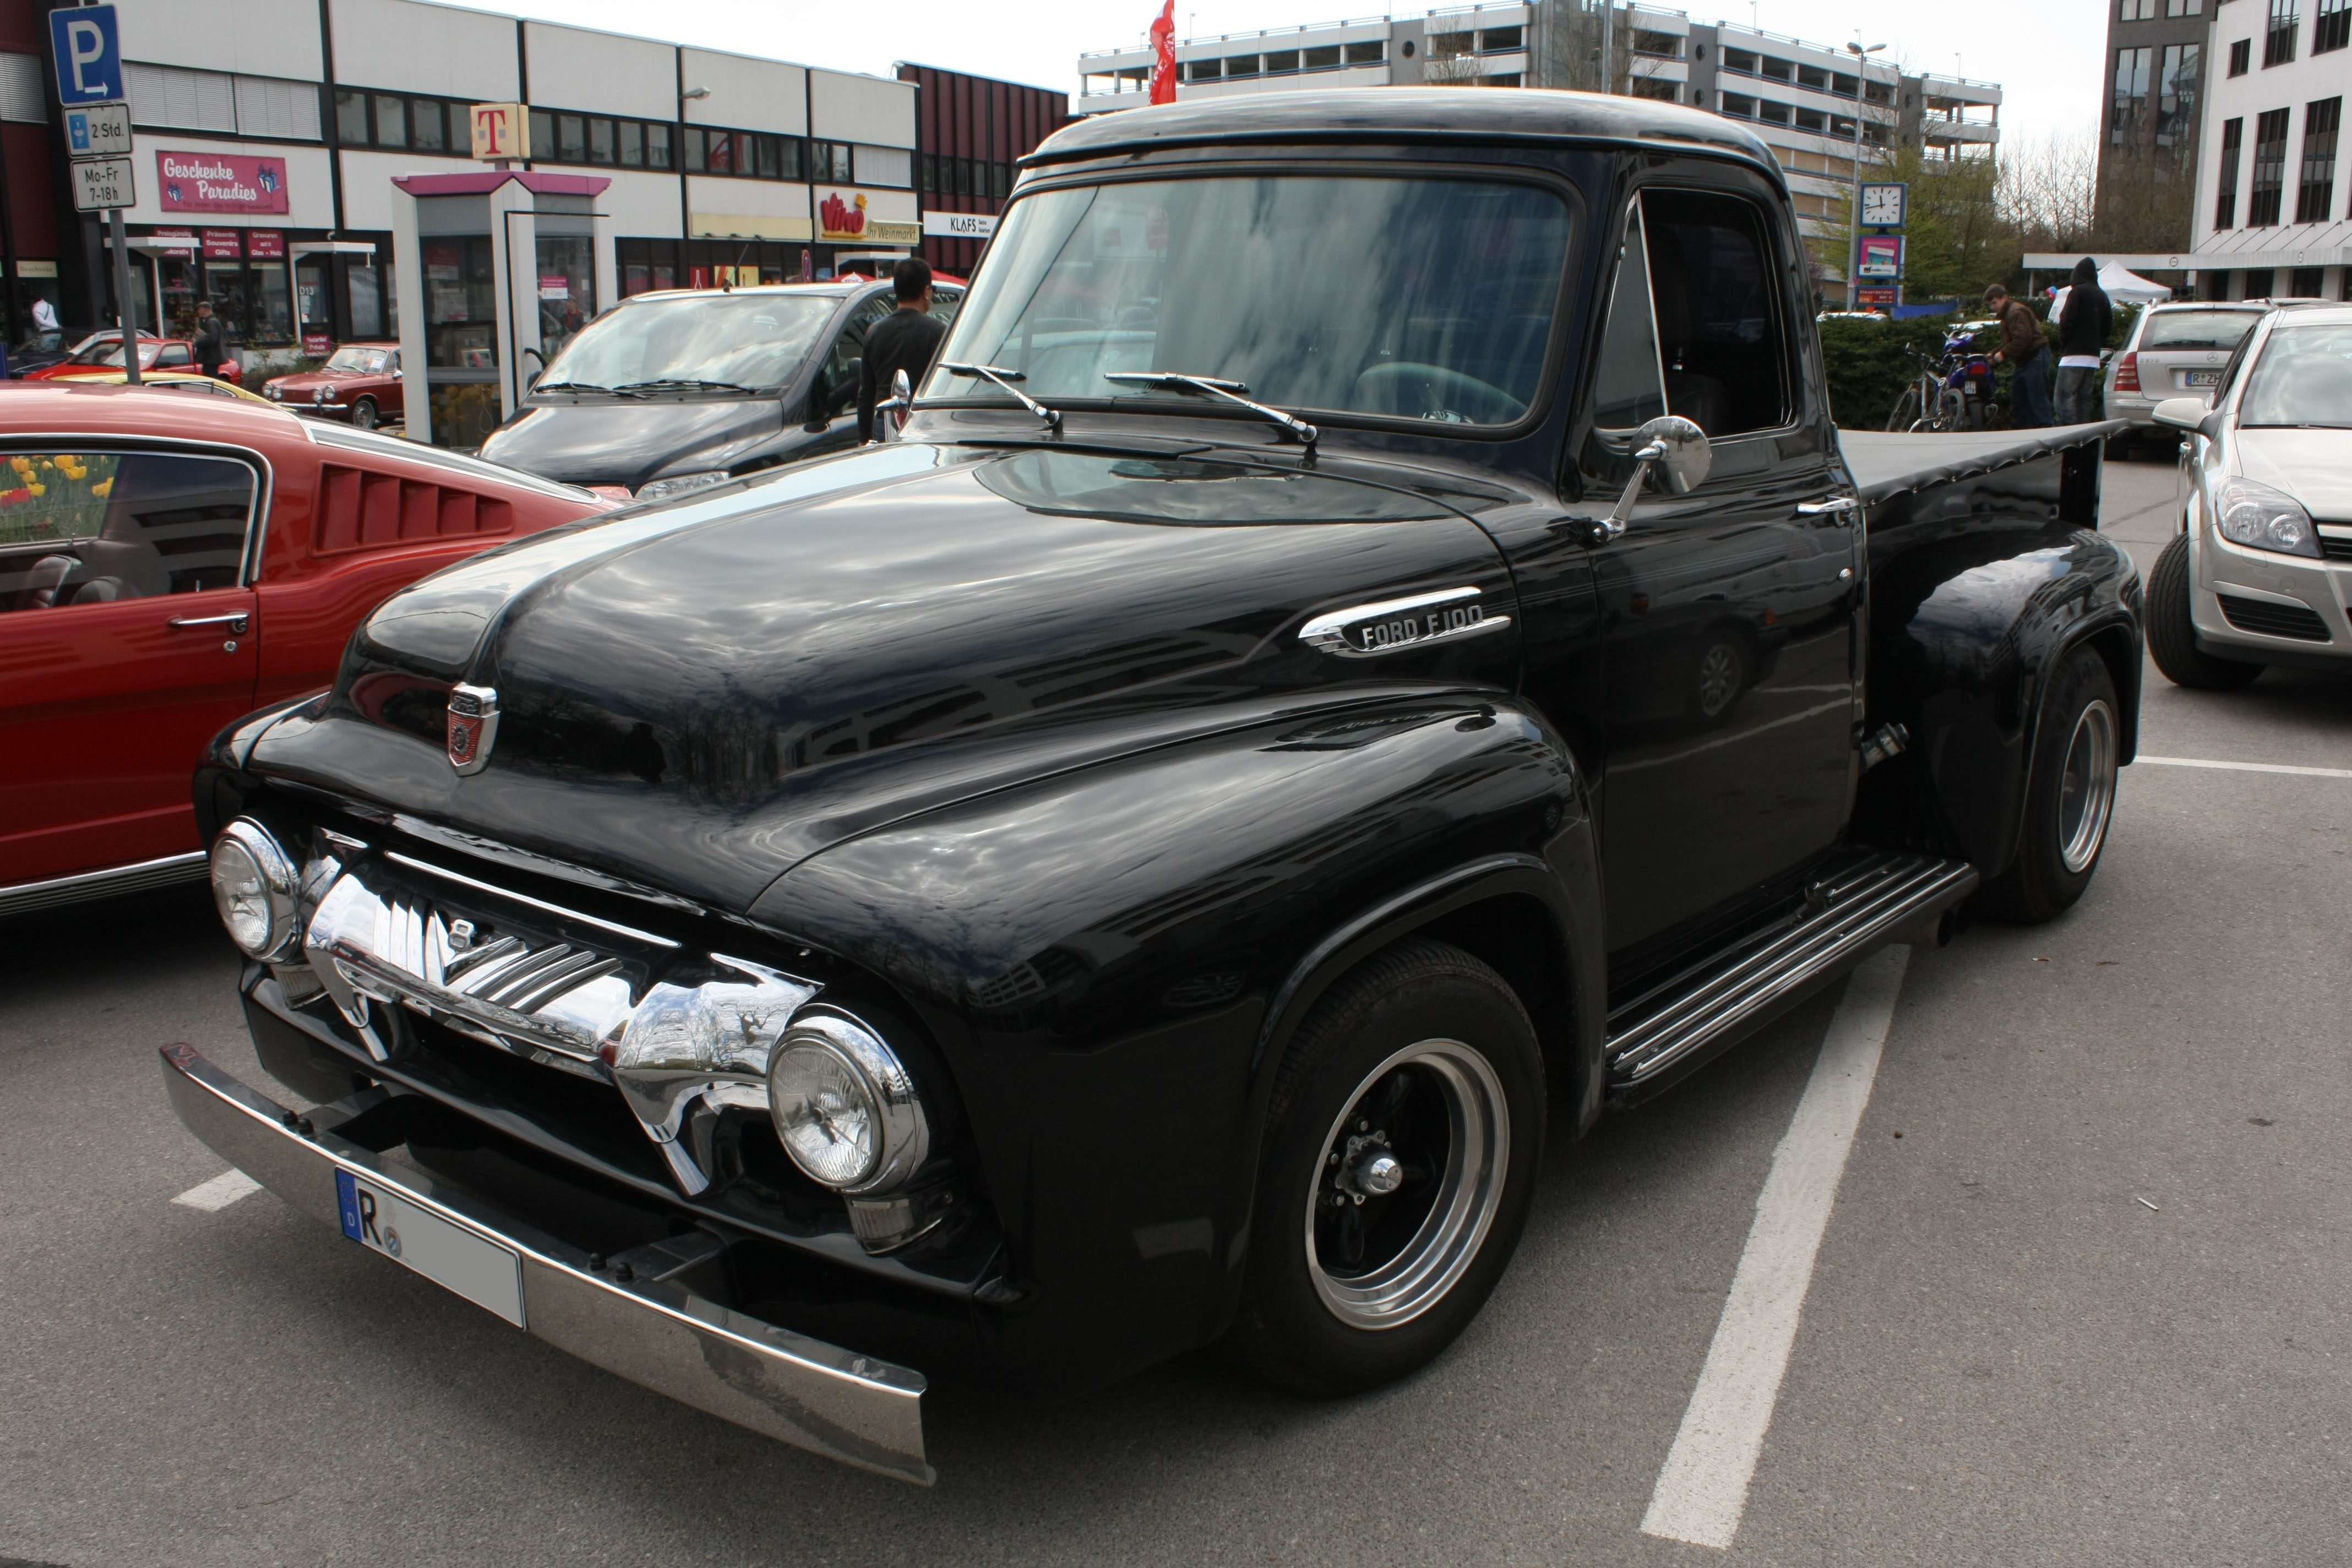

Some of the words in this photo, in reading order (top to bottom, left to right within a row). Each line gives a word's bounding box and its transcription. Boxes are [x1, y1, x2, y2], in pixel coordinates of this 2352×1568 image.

[67, 20, 104, 91] P
[91, 124, 99, 138] 2
[101, 123, 124, 138] Std.
[478, 110, 505, 154] T
[85, 167, 118, 183] Mo-Fr
[164, 157, 235, 180] Geschenke
[197, 180, 257, 201] Paradies
[867, 226, 876, 237] Ihr
[878, 226, 918, 241] Weinmarkt.
[950, 217, 977, 232] KLAFS
[300, 286, 314, 296] D13
[2193, 374, 2199, 384] R
[1362, 619, 1418, 647] FORD
[347, 1212, 355, 1227] D
[358, 1188, 382, 1246] R
